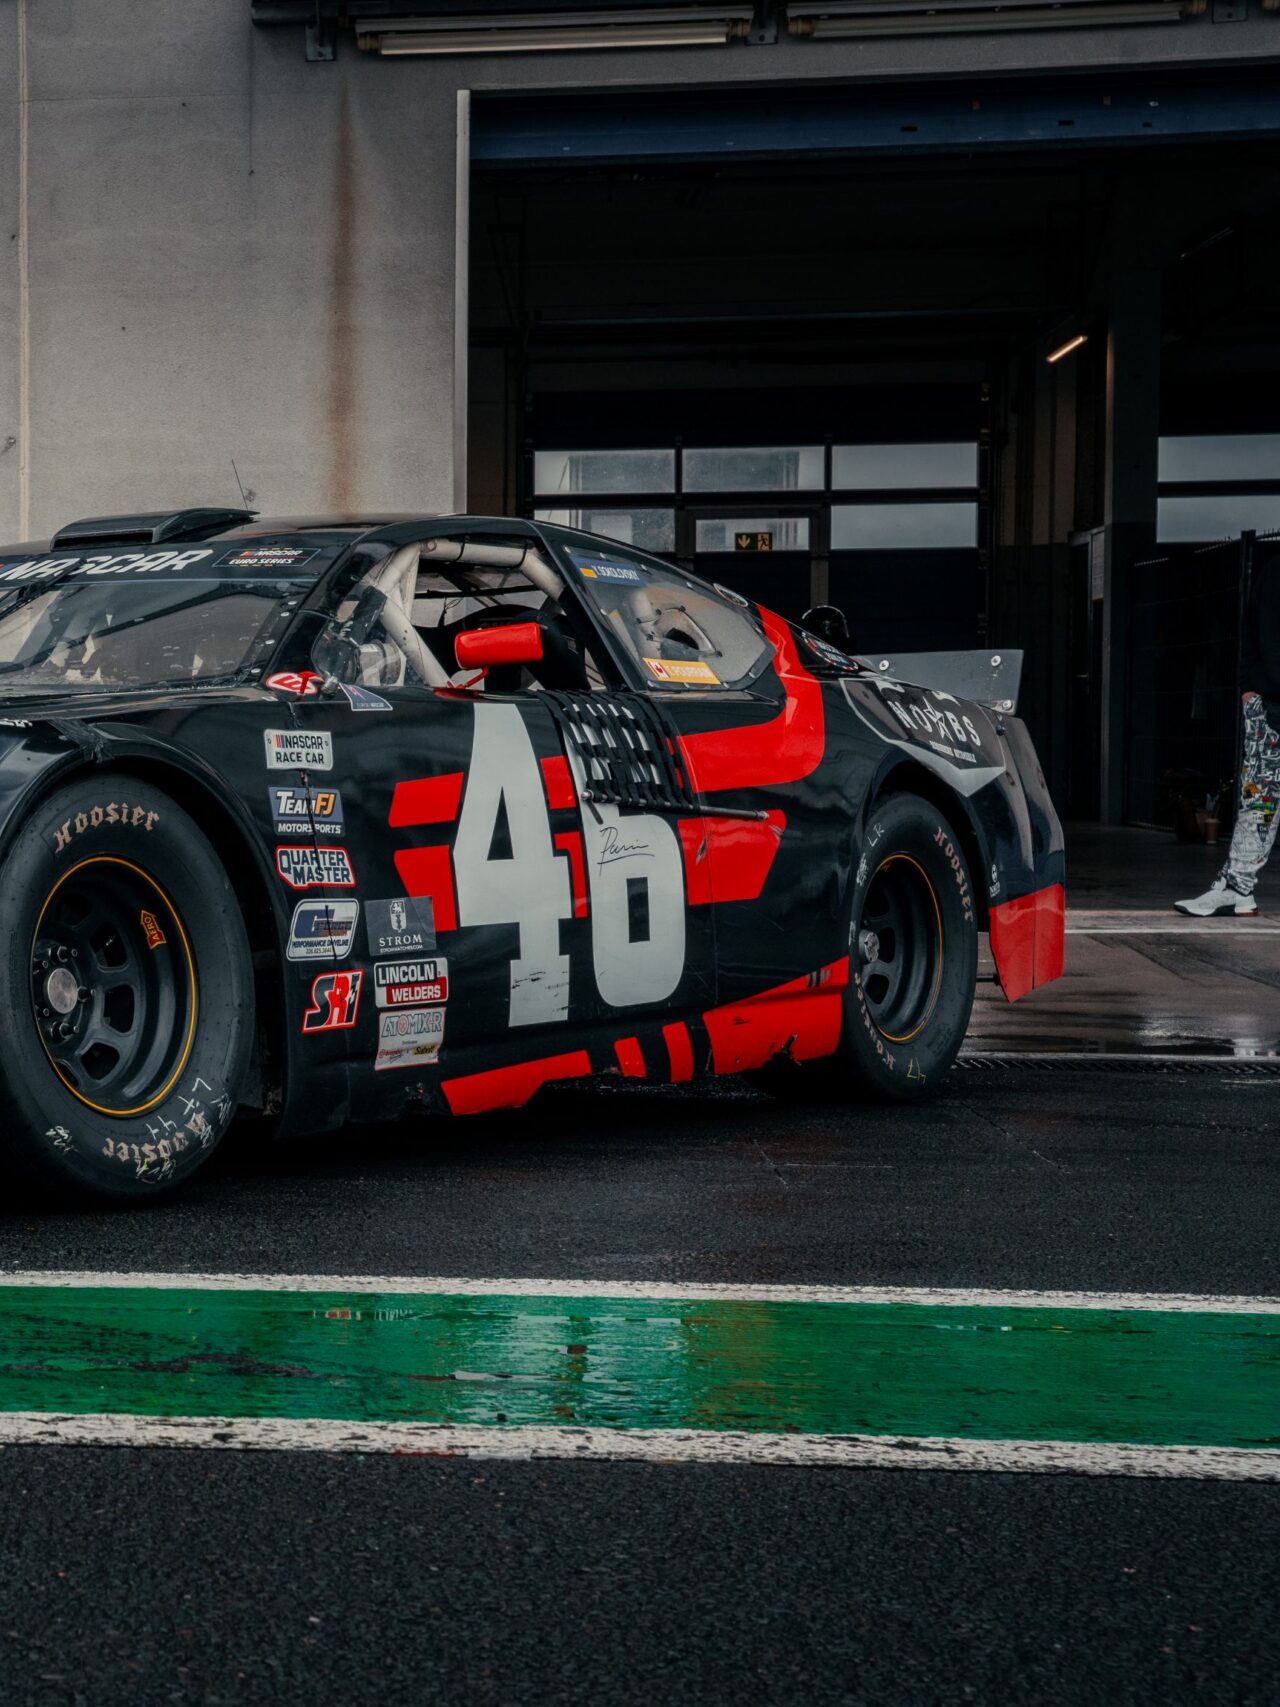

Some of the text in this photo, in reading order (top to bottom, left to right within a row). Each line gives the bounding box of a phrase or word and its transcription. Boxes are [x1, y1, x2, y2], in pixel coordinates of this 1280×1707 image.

[285, 735, 324, 749] NASCAR
[276, 751, 325, 764] RACE CAR
[278, 823, 342, 834] MOTORSPORTS
[278, 849, 347, 875] QUARTER
[453, 702, 687, 1027] 46
[292, 866, 352, 886] MASTER
[379, 934, 423, 947] STROM
[378, 963, 435, 985] LINCOLN
[391, 985, 441, 1002] WELDERS
